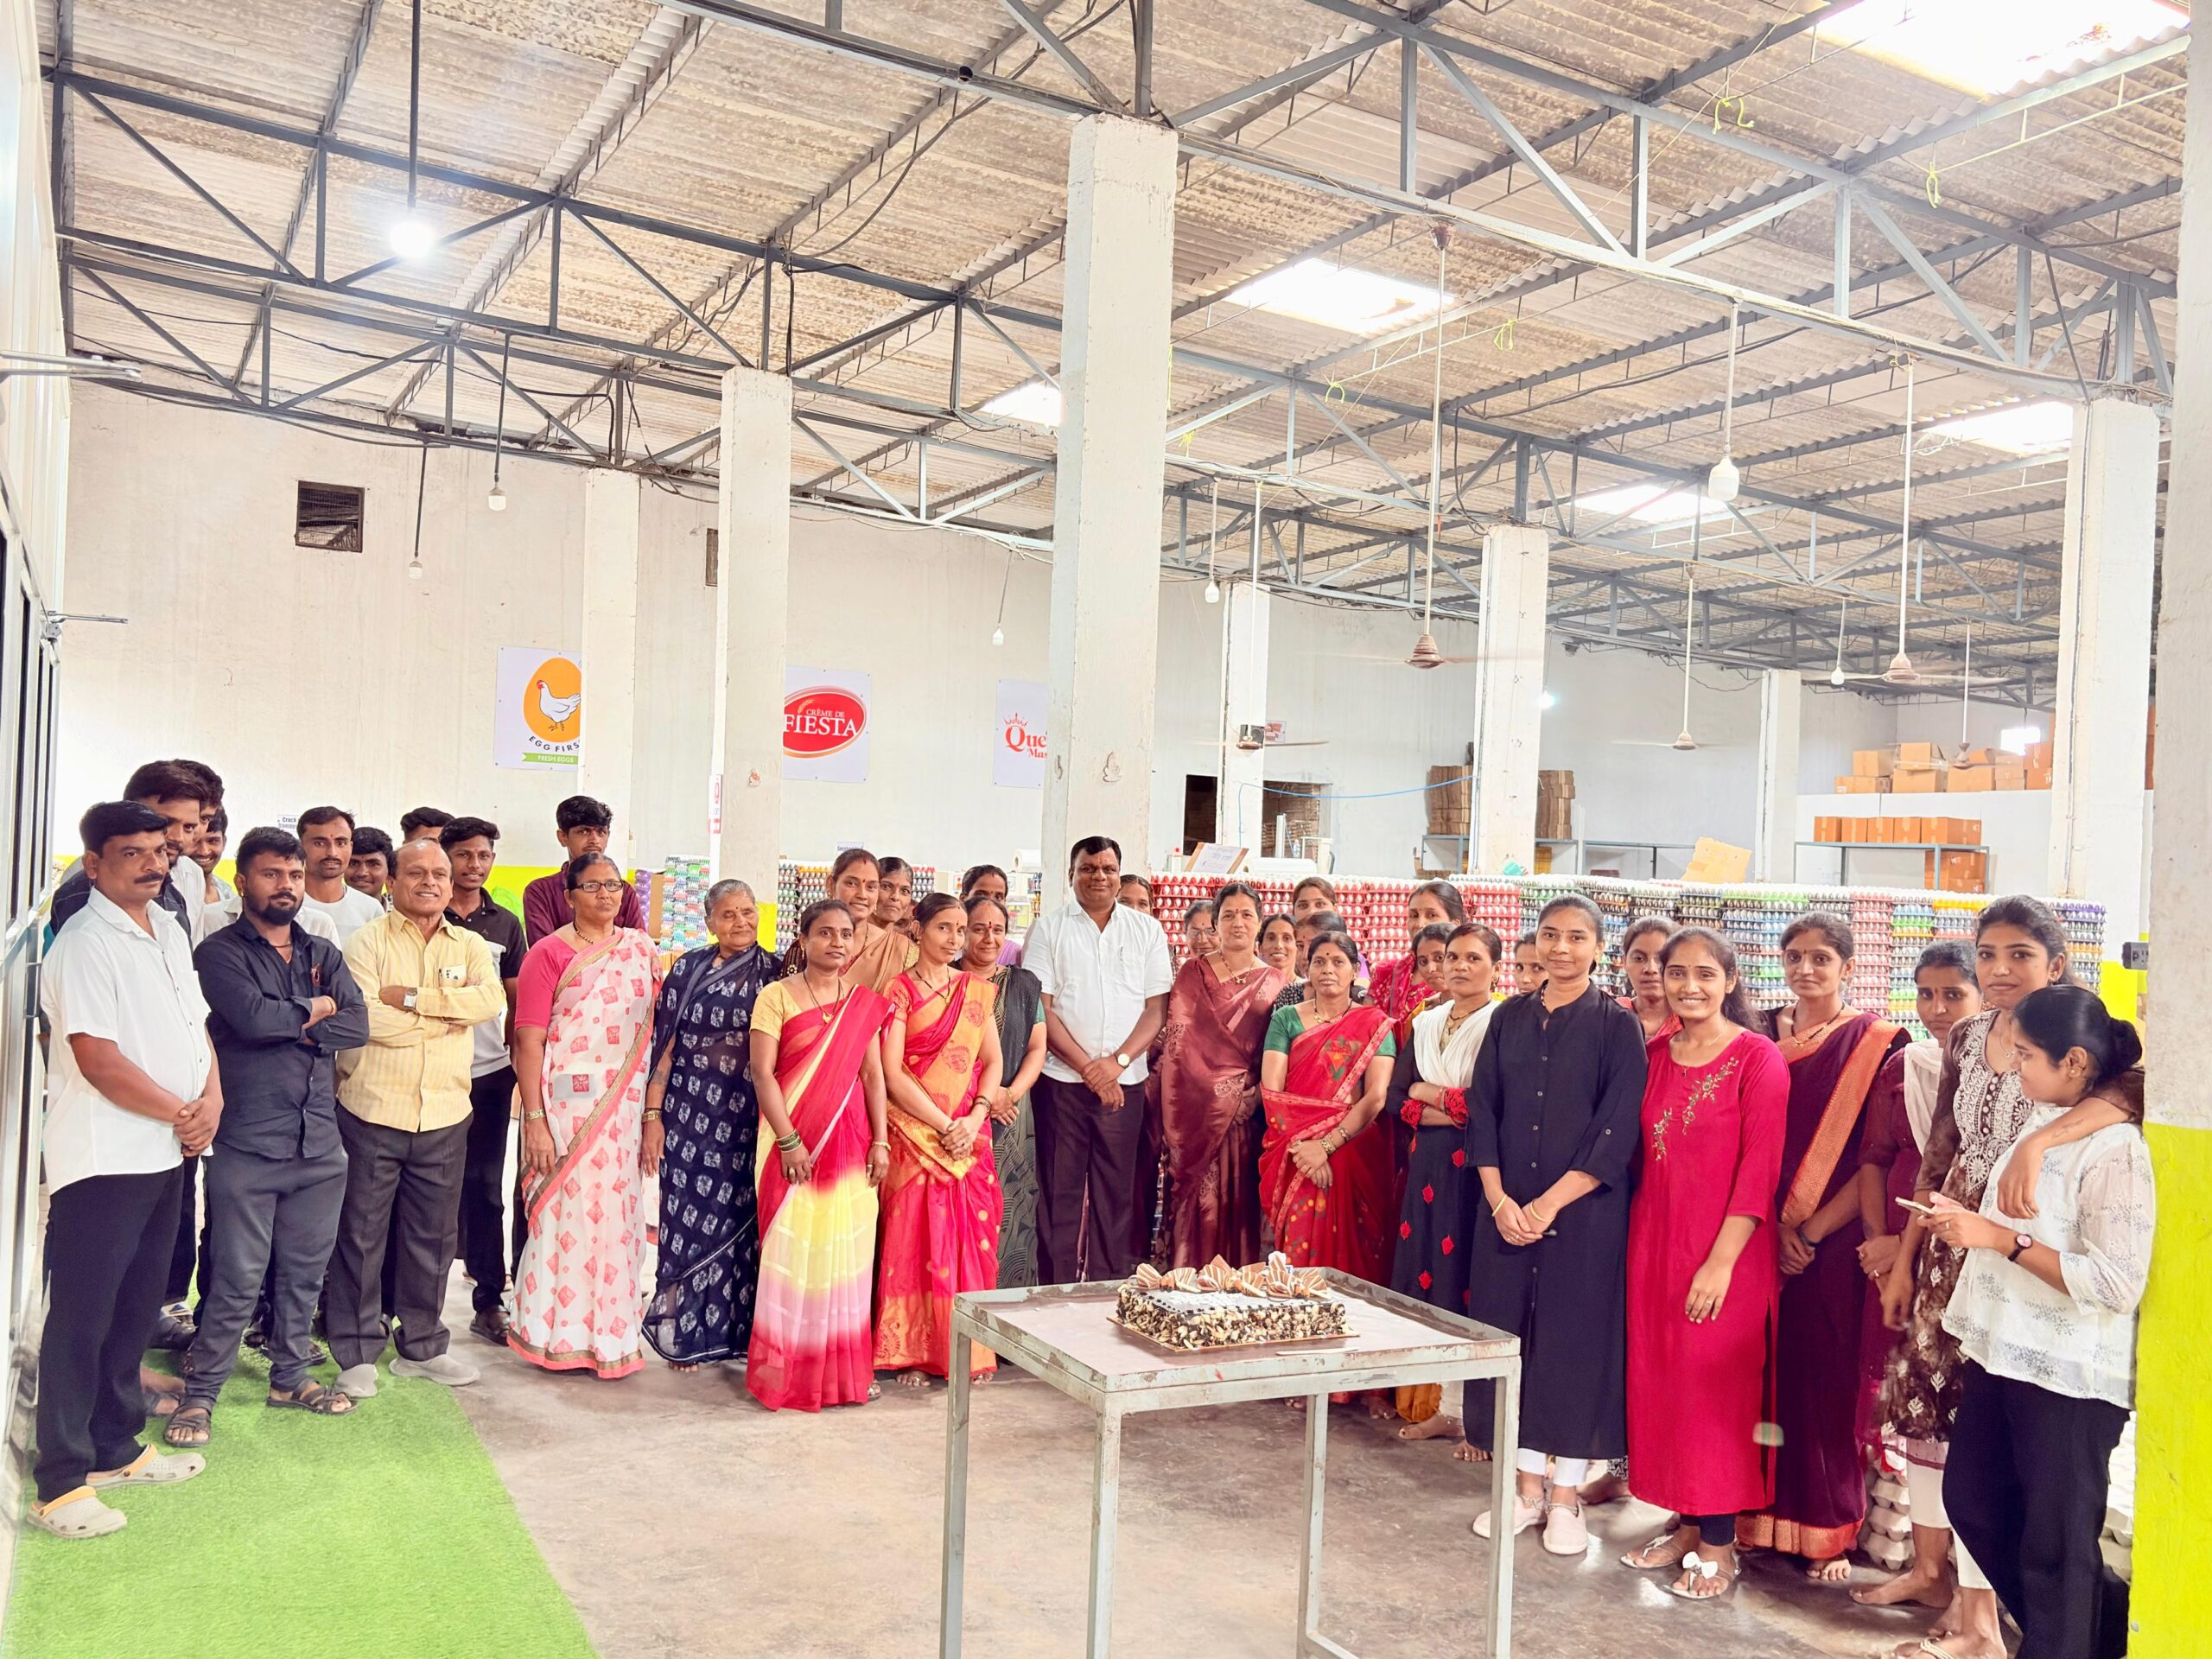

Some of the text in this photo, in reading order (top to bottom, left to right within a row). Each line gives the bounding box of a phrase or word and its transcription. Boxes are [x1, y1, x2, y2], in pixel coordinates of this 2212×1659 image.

[806, 708, 833, 717] CRÈME
[783, 715, 857, 736] FIESTA
[529, 736, 580, 752] EGG FIRS
